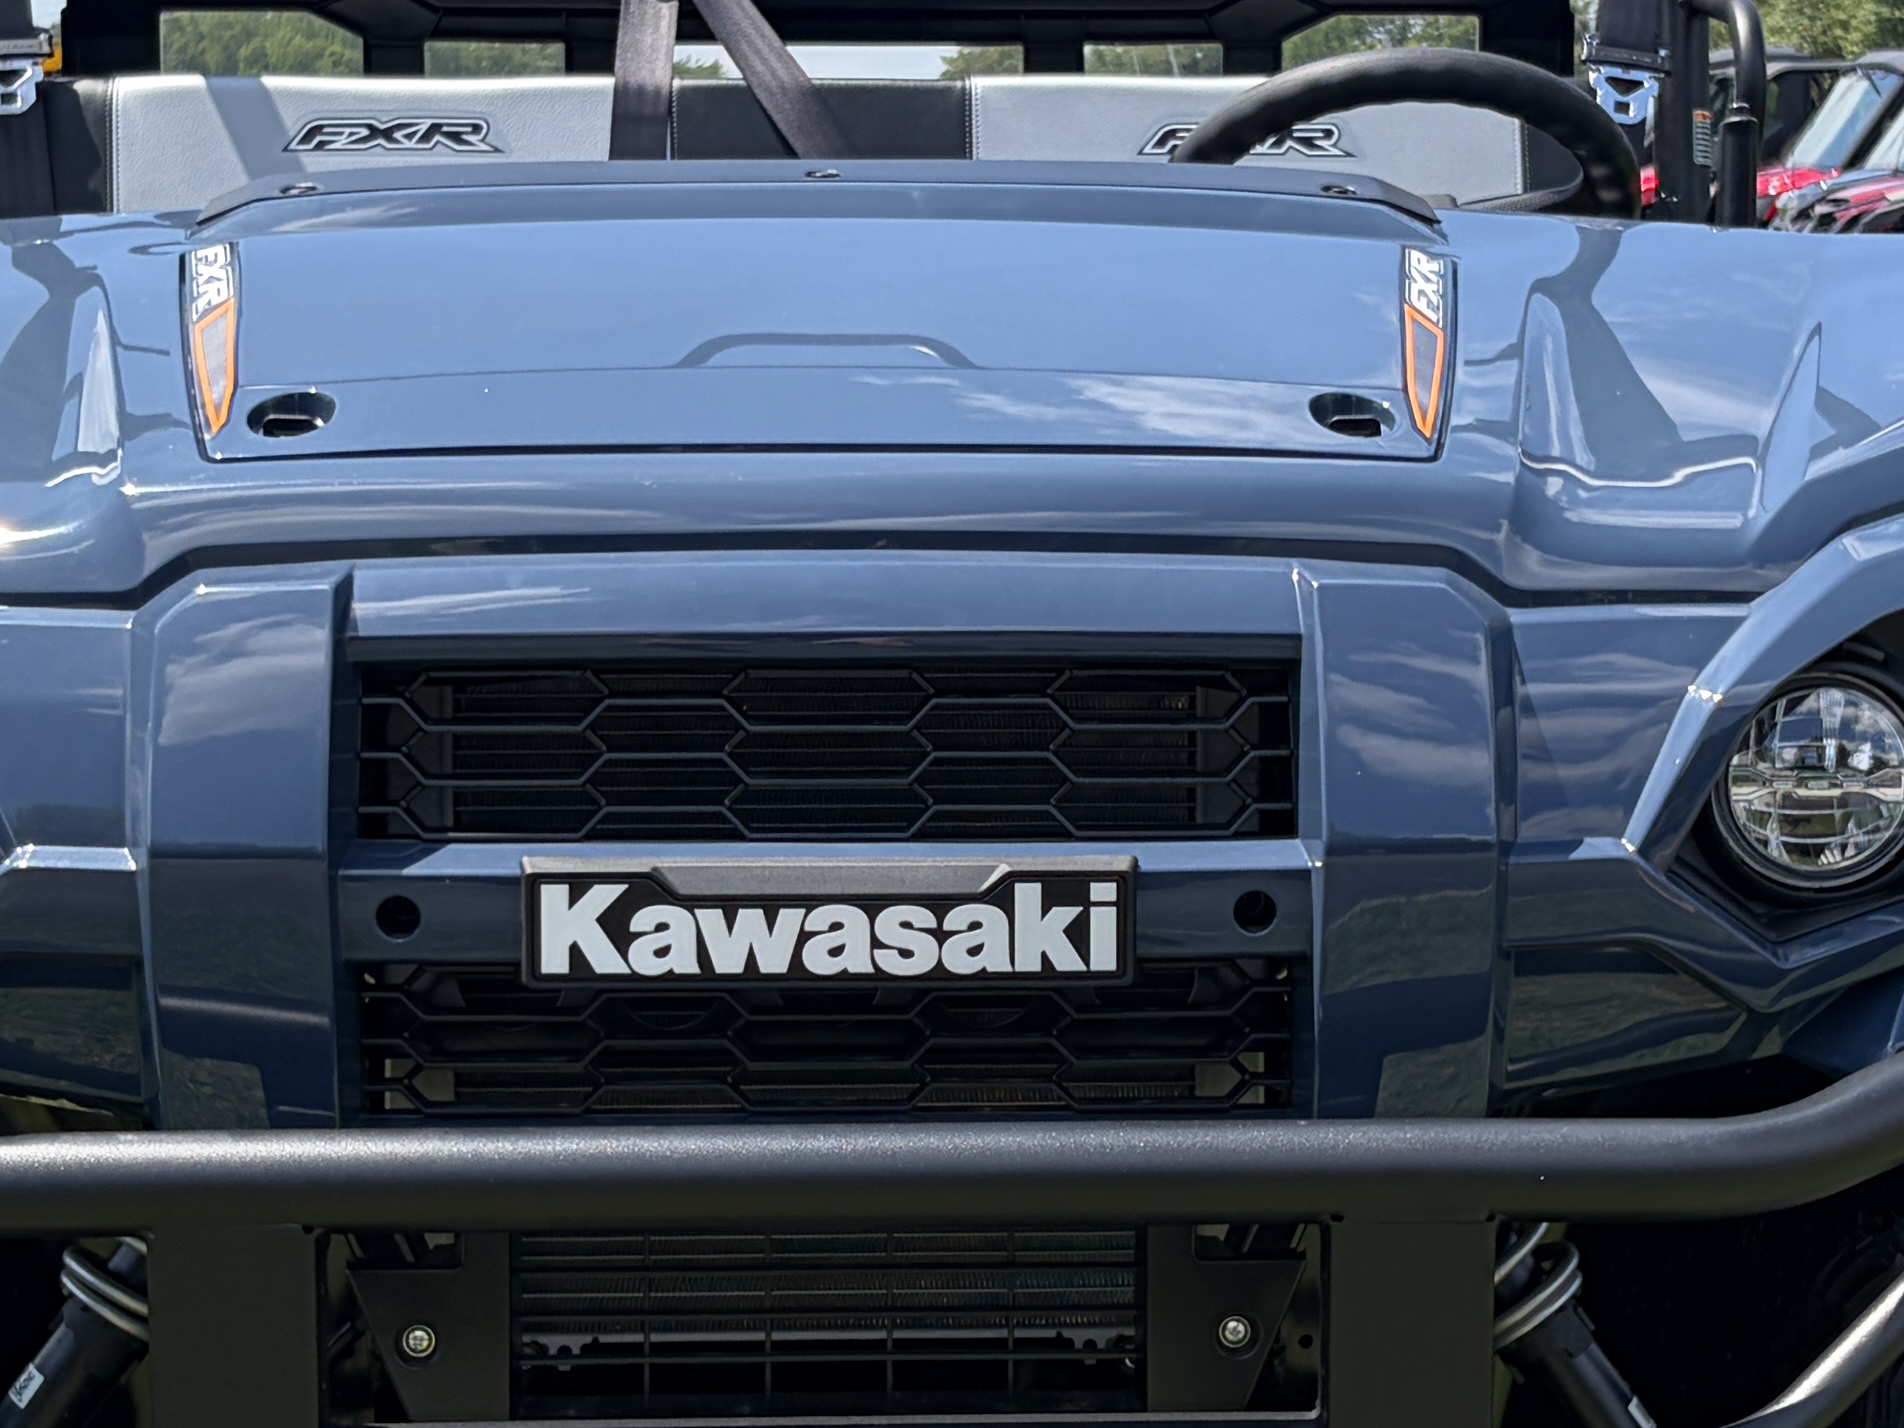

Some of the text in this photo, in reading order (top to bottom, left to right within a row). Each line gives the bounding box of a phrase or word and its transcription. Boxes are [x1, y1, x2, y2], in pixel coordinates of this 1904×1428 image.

[283, 117, 504, 153] FXR
[1137, 123, 1355, 158] FR
[192, 244, 234, 322] FXR
[1405, 248, 1443, 328] FXR
[540, 882, 1118, 977] Kawasaki
